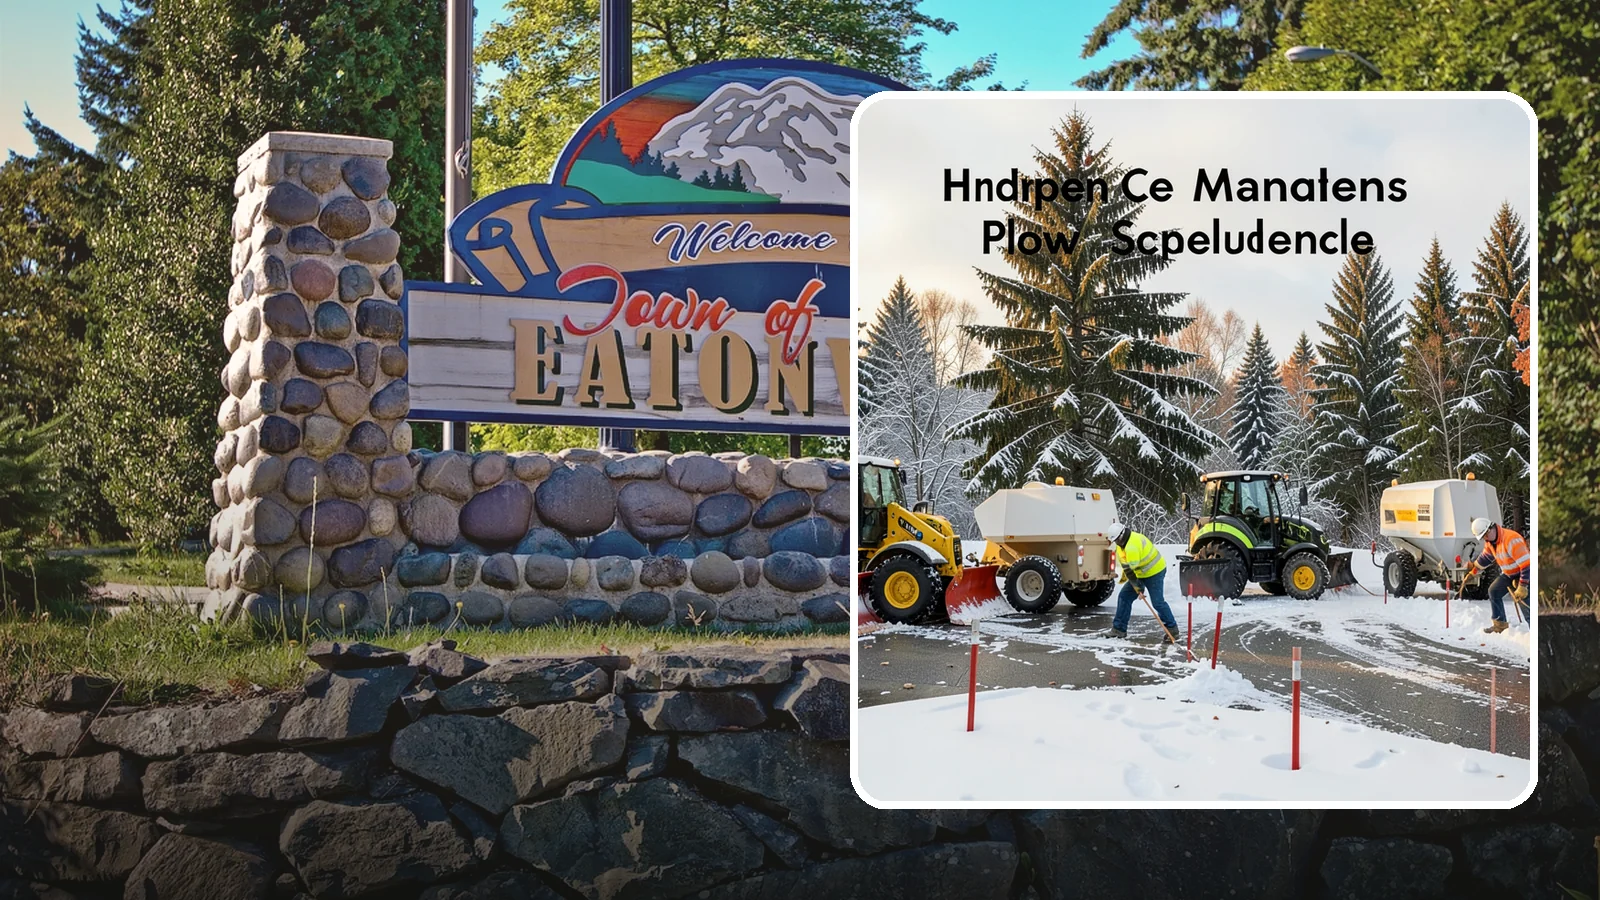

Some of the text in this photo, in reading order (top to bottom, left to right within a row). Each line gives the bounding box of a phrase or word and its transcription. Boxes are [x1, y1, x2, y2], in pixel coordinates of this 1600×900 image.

[653, 221, 836, 262] Welcome
[557, 263, 826, 364] Town of
